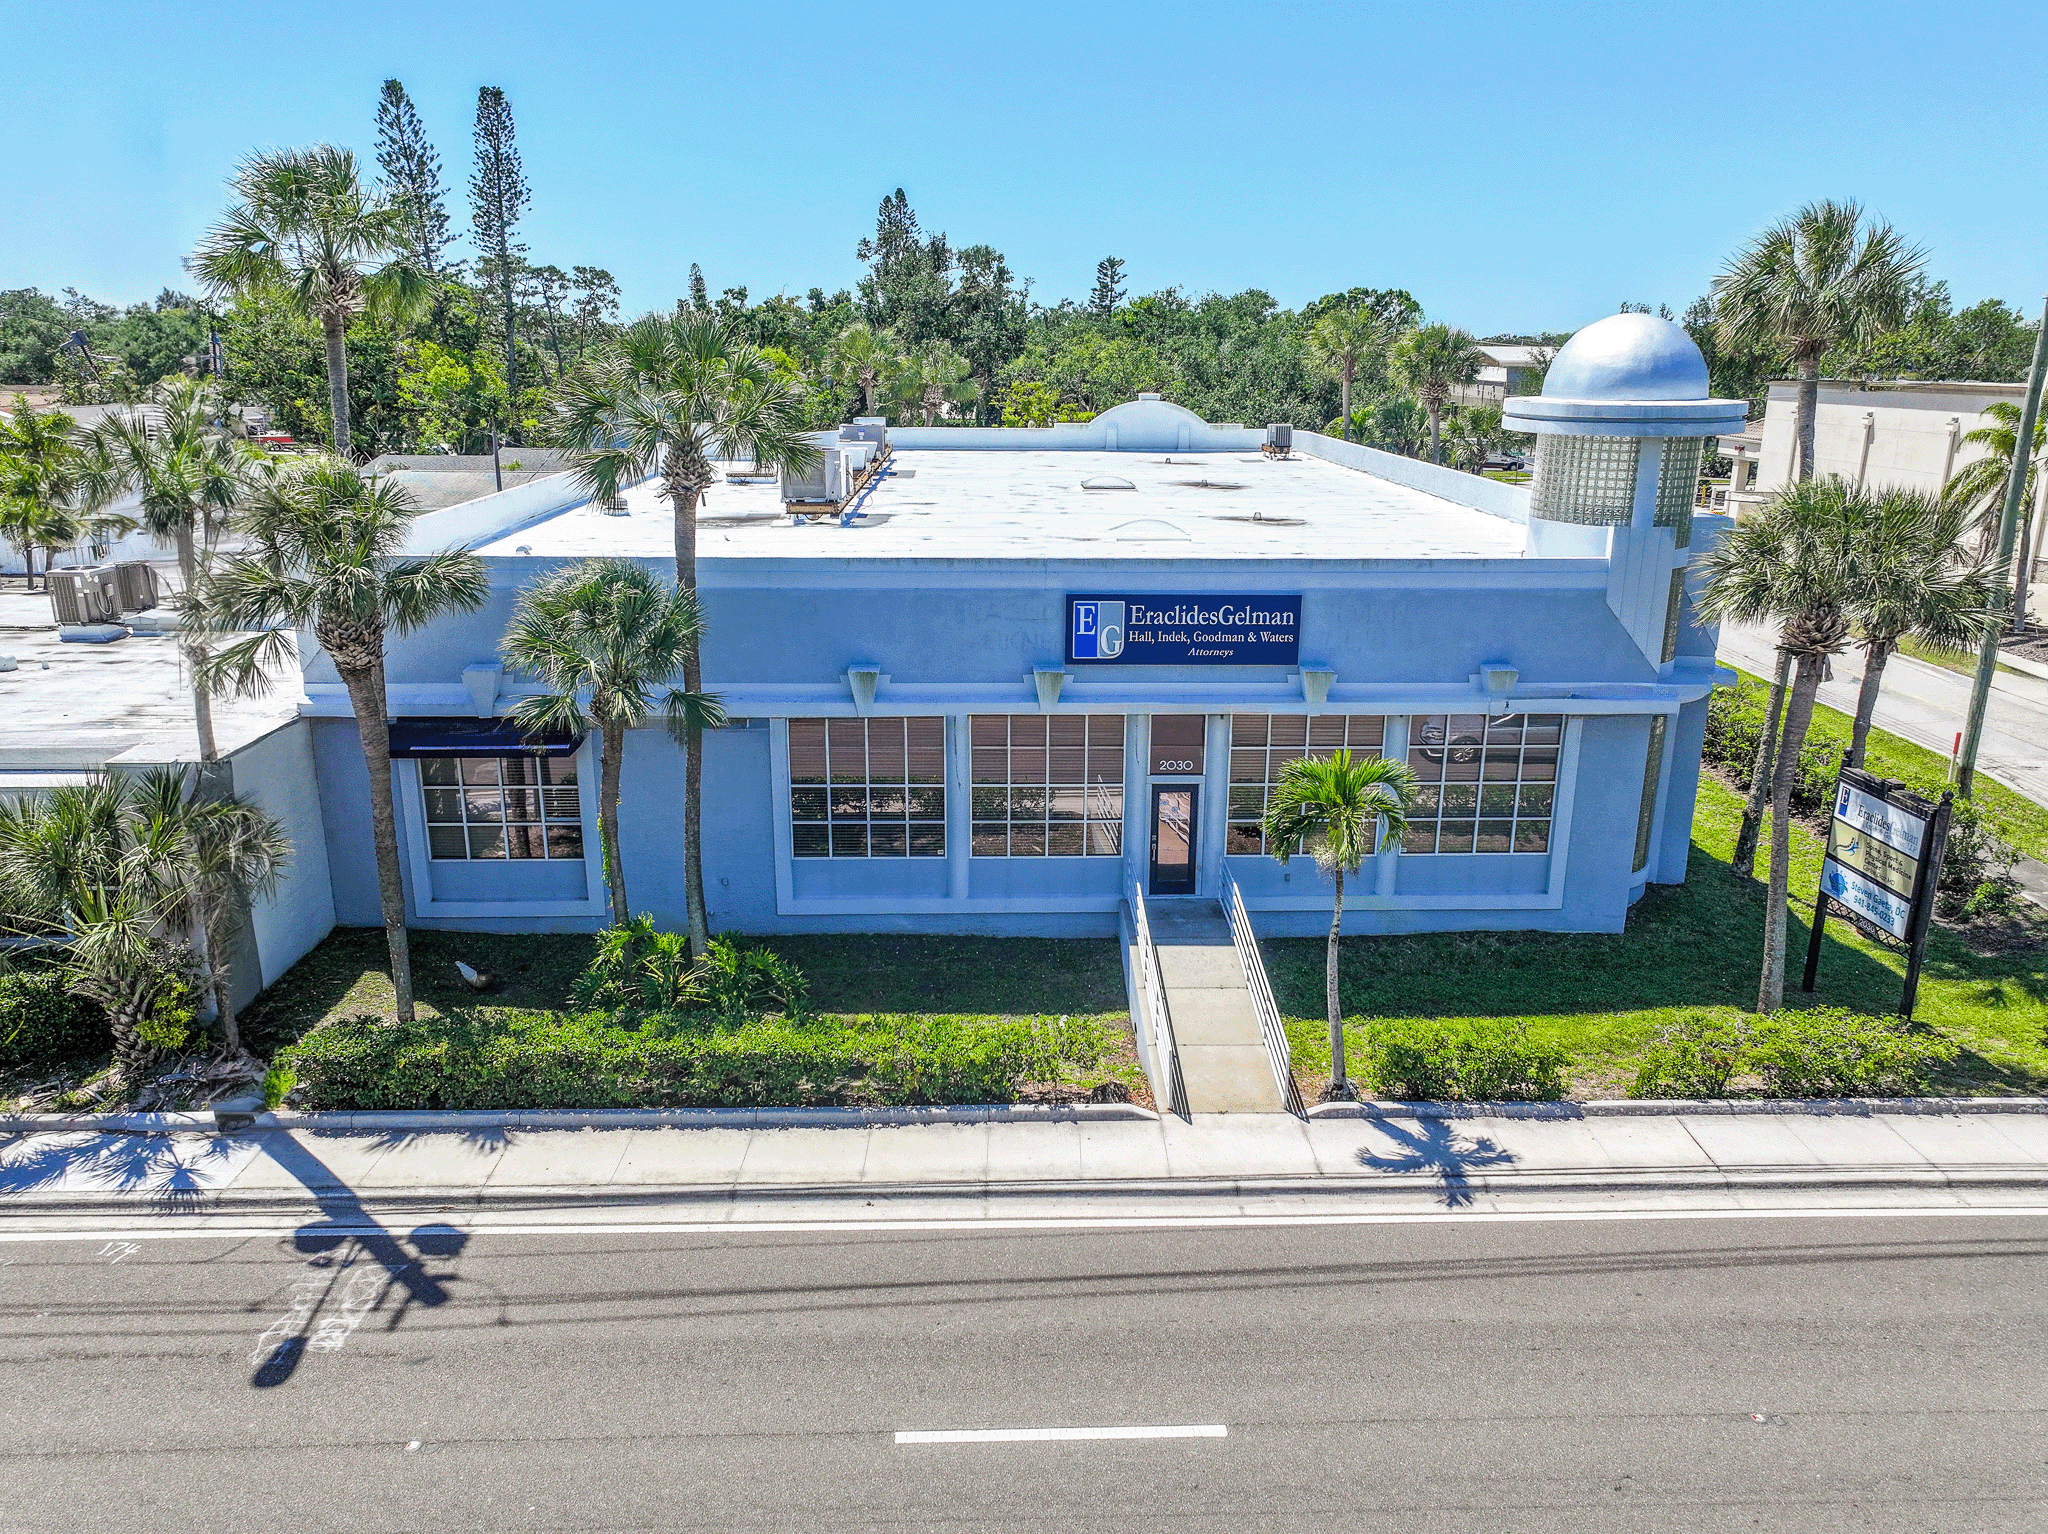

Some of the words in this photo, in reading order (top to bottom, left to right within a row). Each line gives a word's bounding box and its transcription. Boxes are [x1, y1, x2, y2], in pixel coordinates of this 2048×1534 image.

[1077, 605, 1096, 635] E
[1129, 604, 1294, 625] EraclidesGelman
[1100, 625, 1121, 655] G
[1128, 631, 1155, 644] Hall,
[1157, 631, 1190, 644] Indek,
[1193, 631, 1245, 643] Goodman
[1247, 631, 1257, 643] &
[1260, 631, 1294, 643] Waters
[1187, 647, 1234, 657] Attorneys
[1159, 760, 1193, 770] 2030
[1851, 881, 1872, 899] Steven
[1873, 893, 1893, 913] Gaeta,
[1894, 906, 1905, 919] DC
[1853, 895, 1895, 926] 941-845-0233
[1859, 917, 1875, 933] 2030
